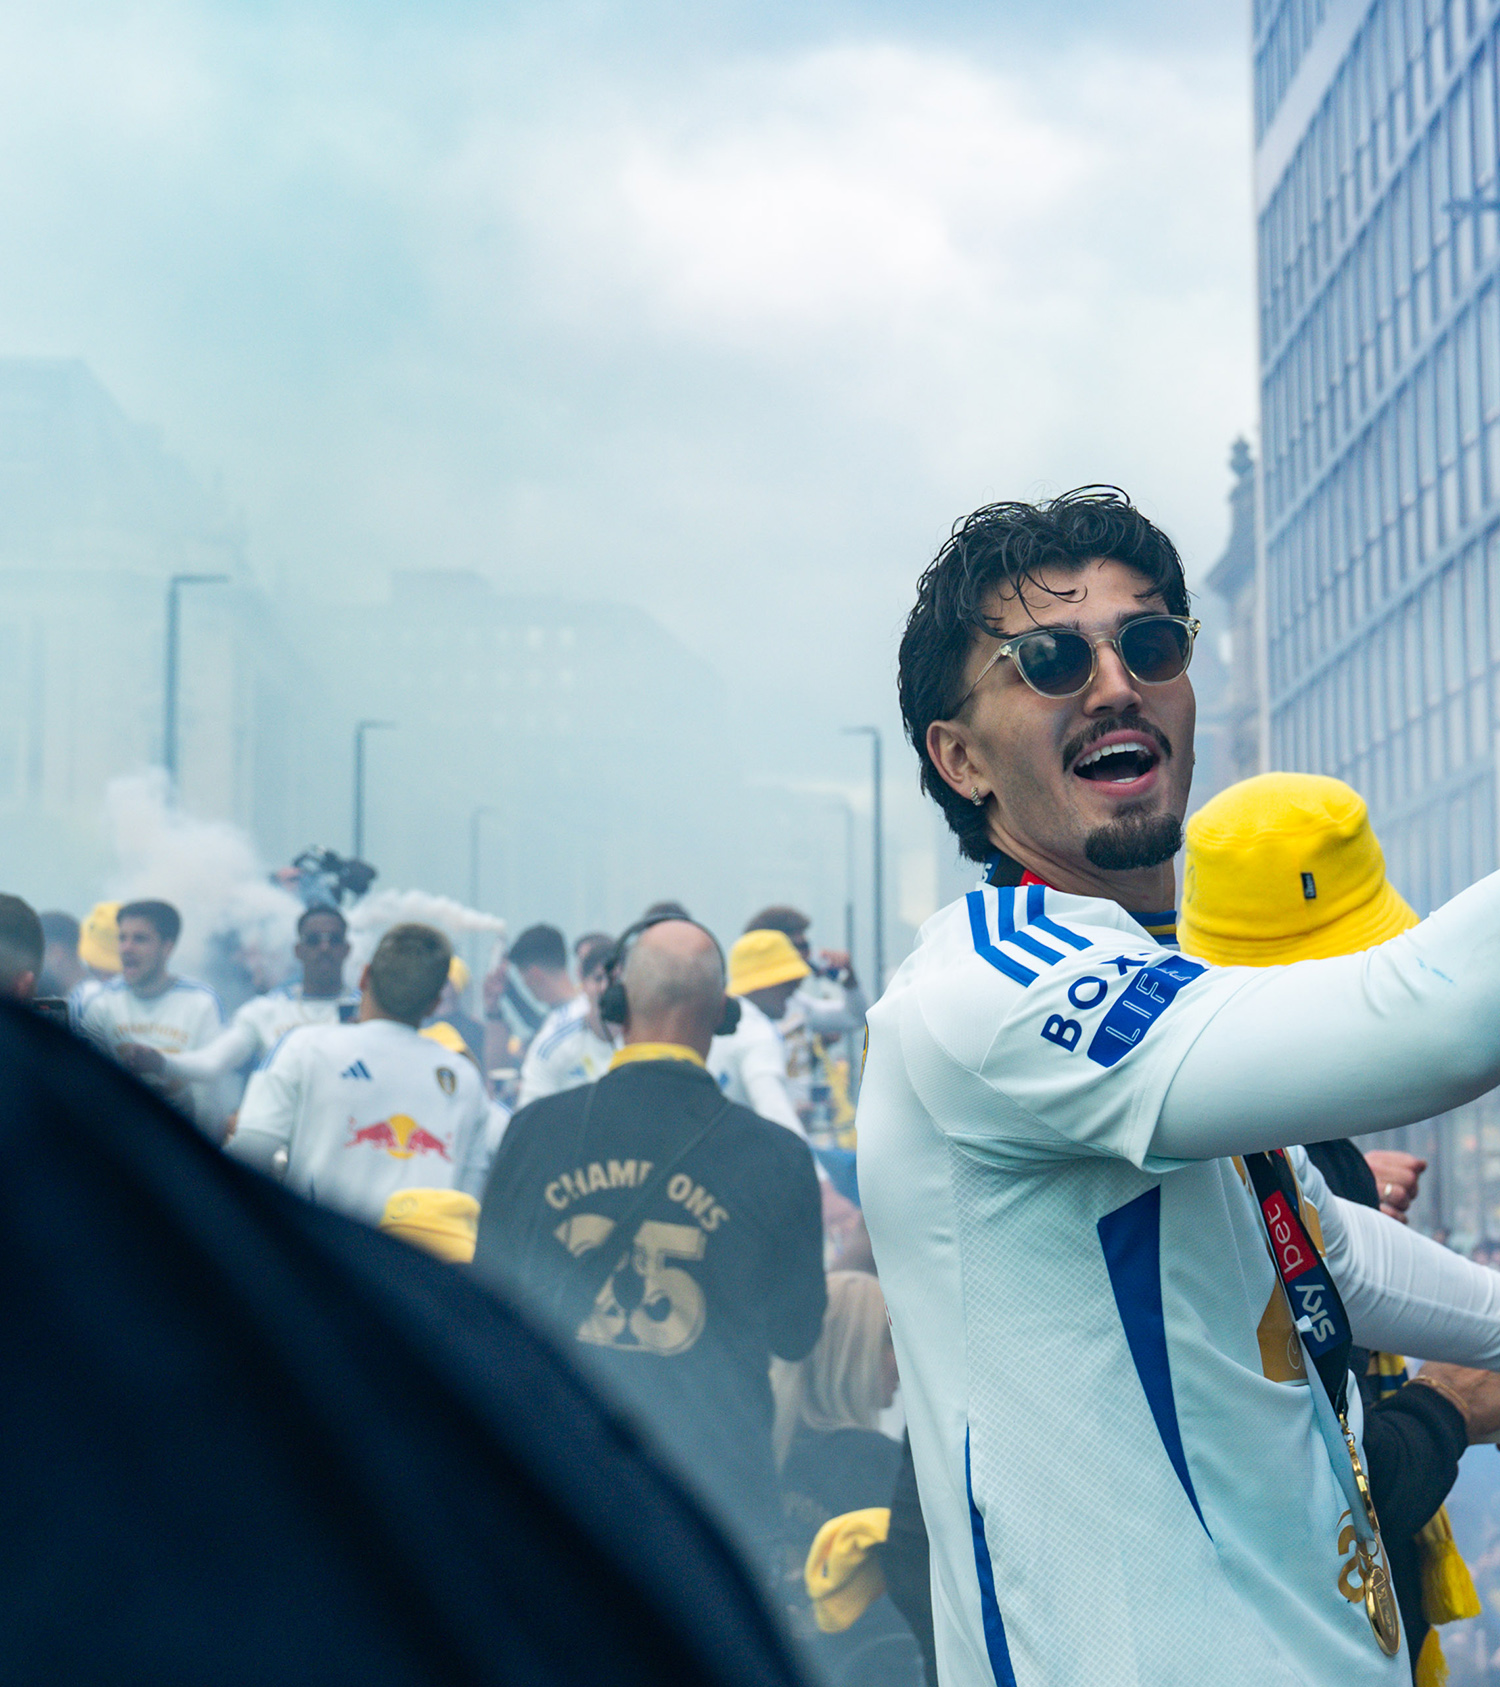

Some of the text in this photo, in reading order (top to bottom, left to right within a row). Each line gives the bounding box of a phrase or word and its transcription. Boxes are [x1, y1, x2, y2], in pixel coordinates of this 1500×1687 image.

[1040, 953, 1152, 1053] BOX
[1267, 1203, 1336, 1343] sky bet
